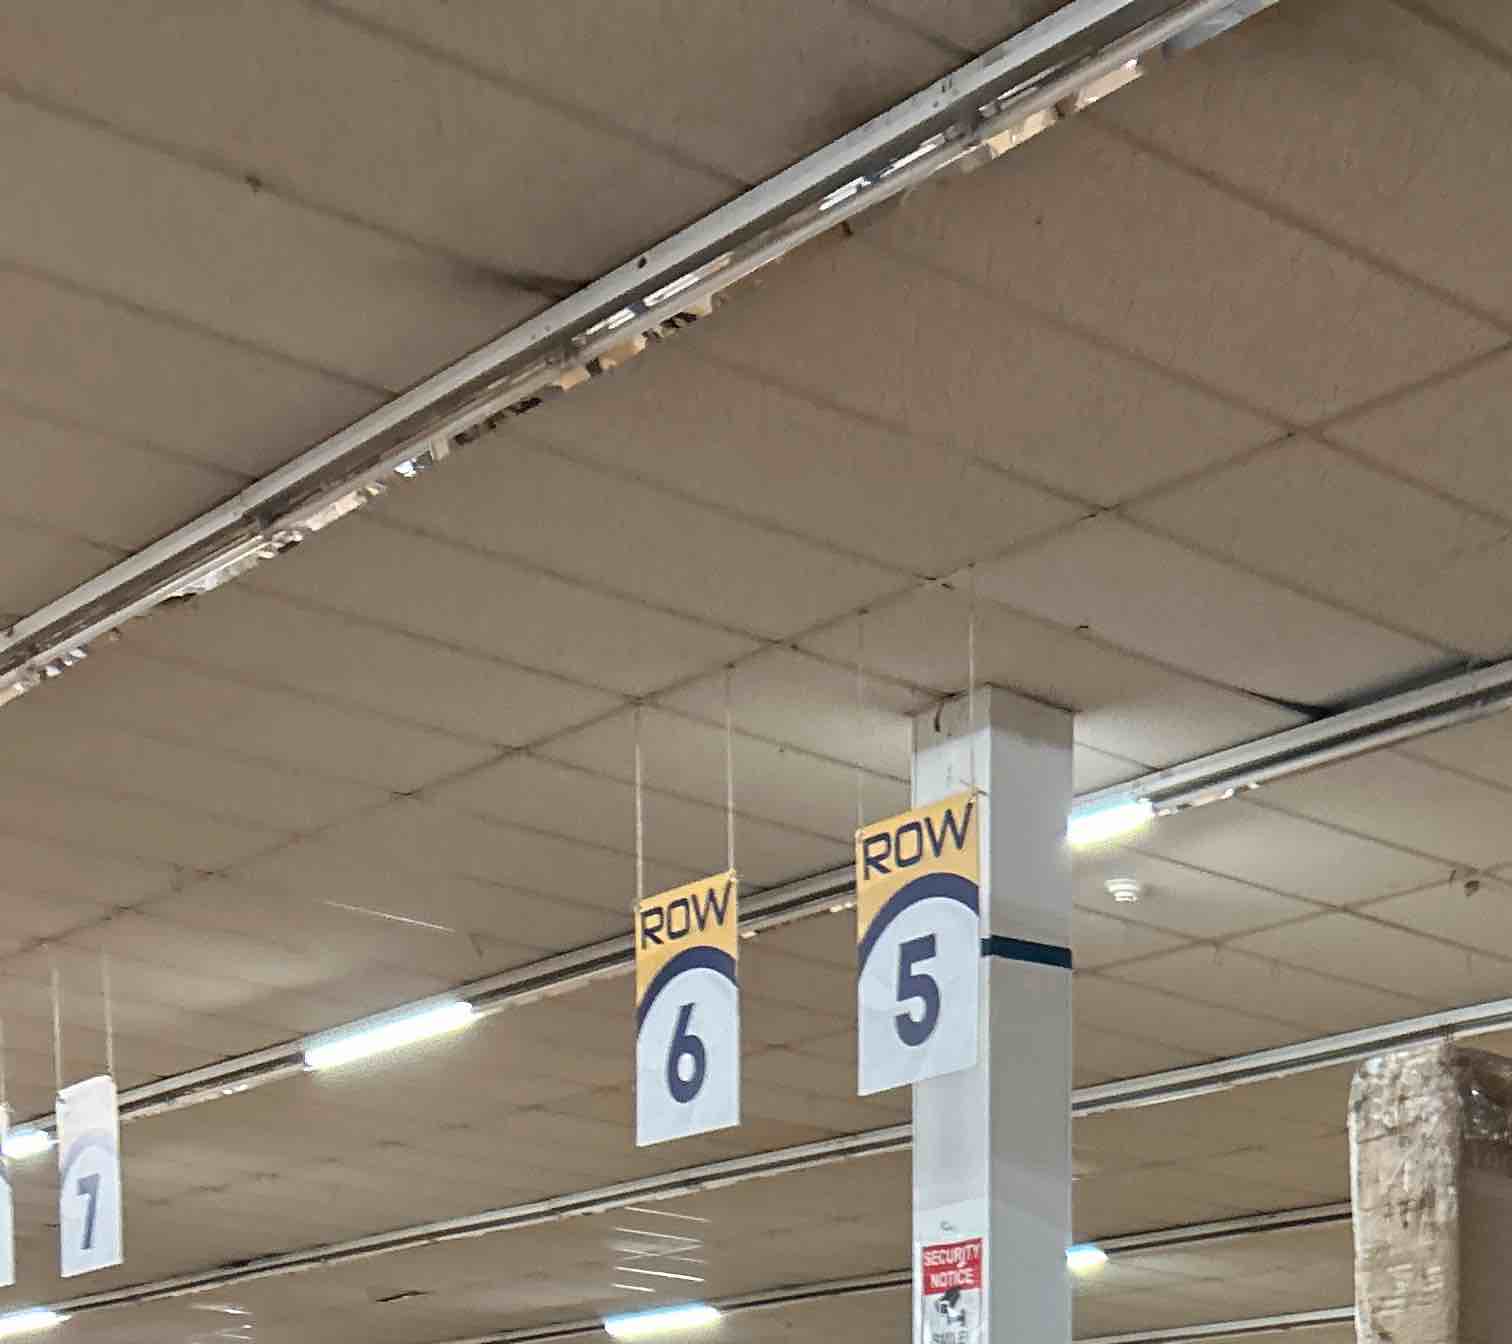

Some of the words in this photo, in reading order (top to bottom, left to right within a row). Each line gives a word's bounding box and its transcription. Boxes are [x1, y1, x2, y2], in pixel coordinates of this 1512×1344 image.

[862, 801, 974, 881] ROW
[639, 880, 733, 951] ROW
[893, 932, 941, 1048] 5
[666, 1001, 707, 1105] 6
[76, 1173, 102, 1250] 7
[923, 1244, 980, 1268] SECURITY
[930, 1267, 976, 1289] NOTICE
